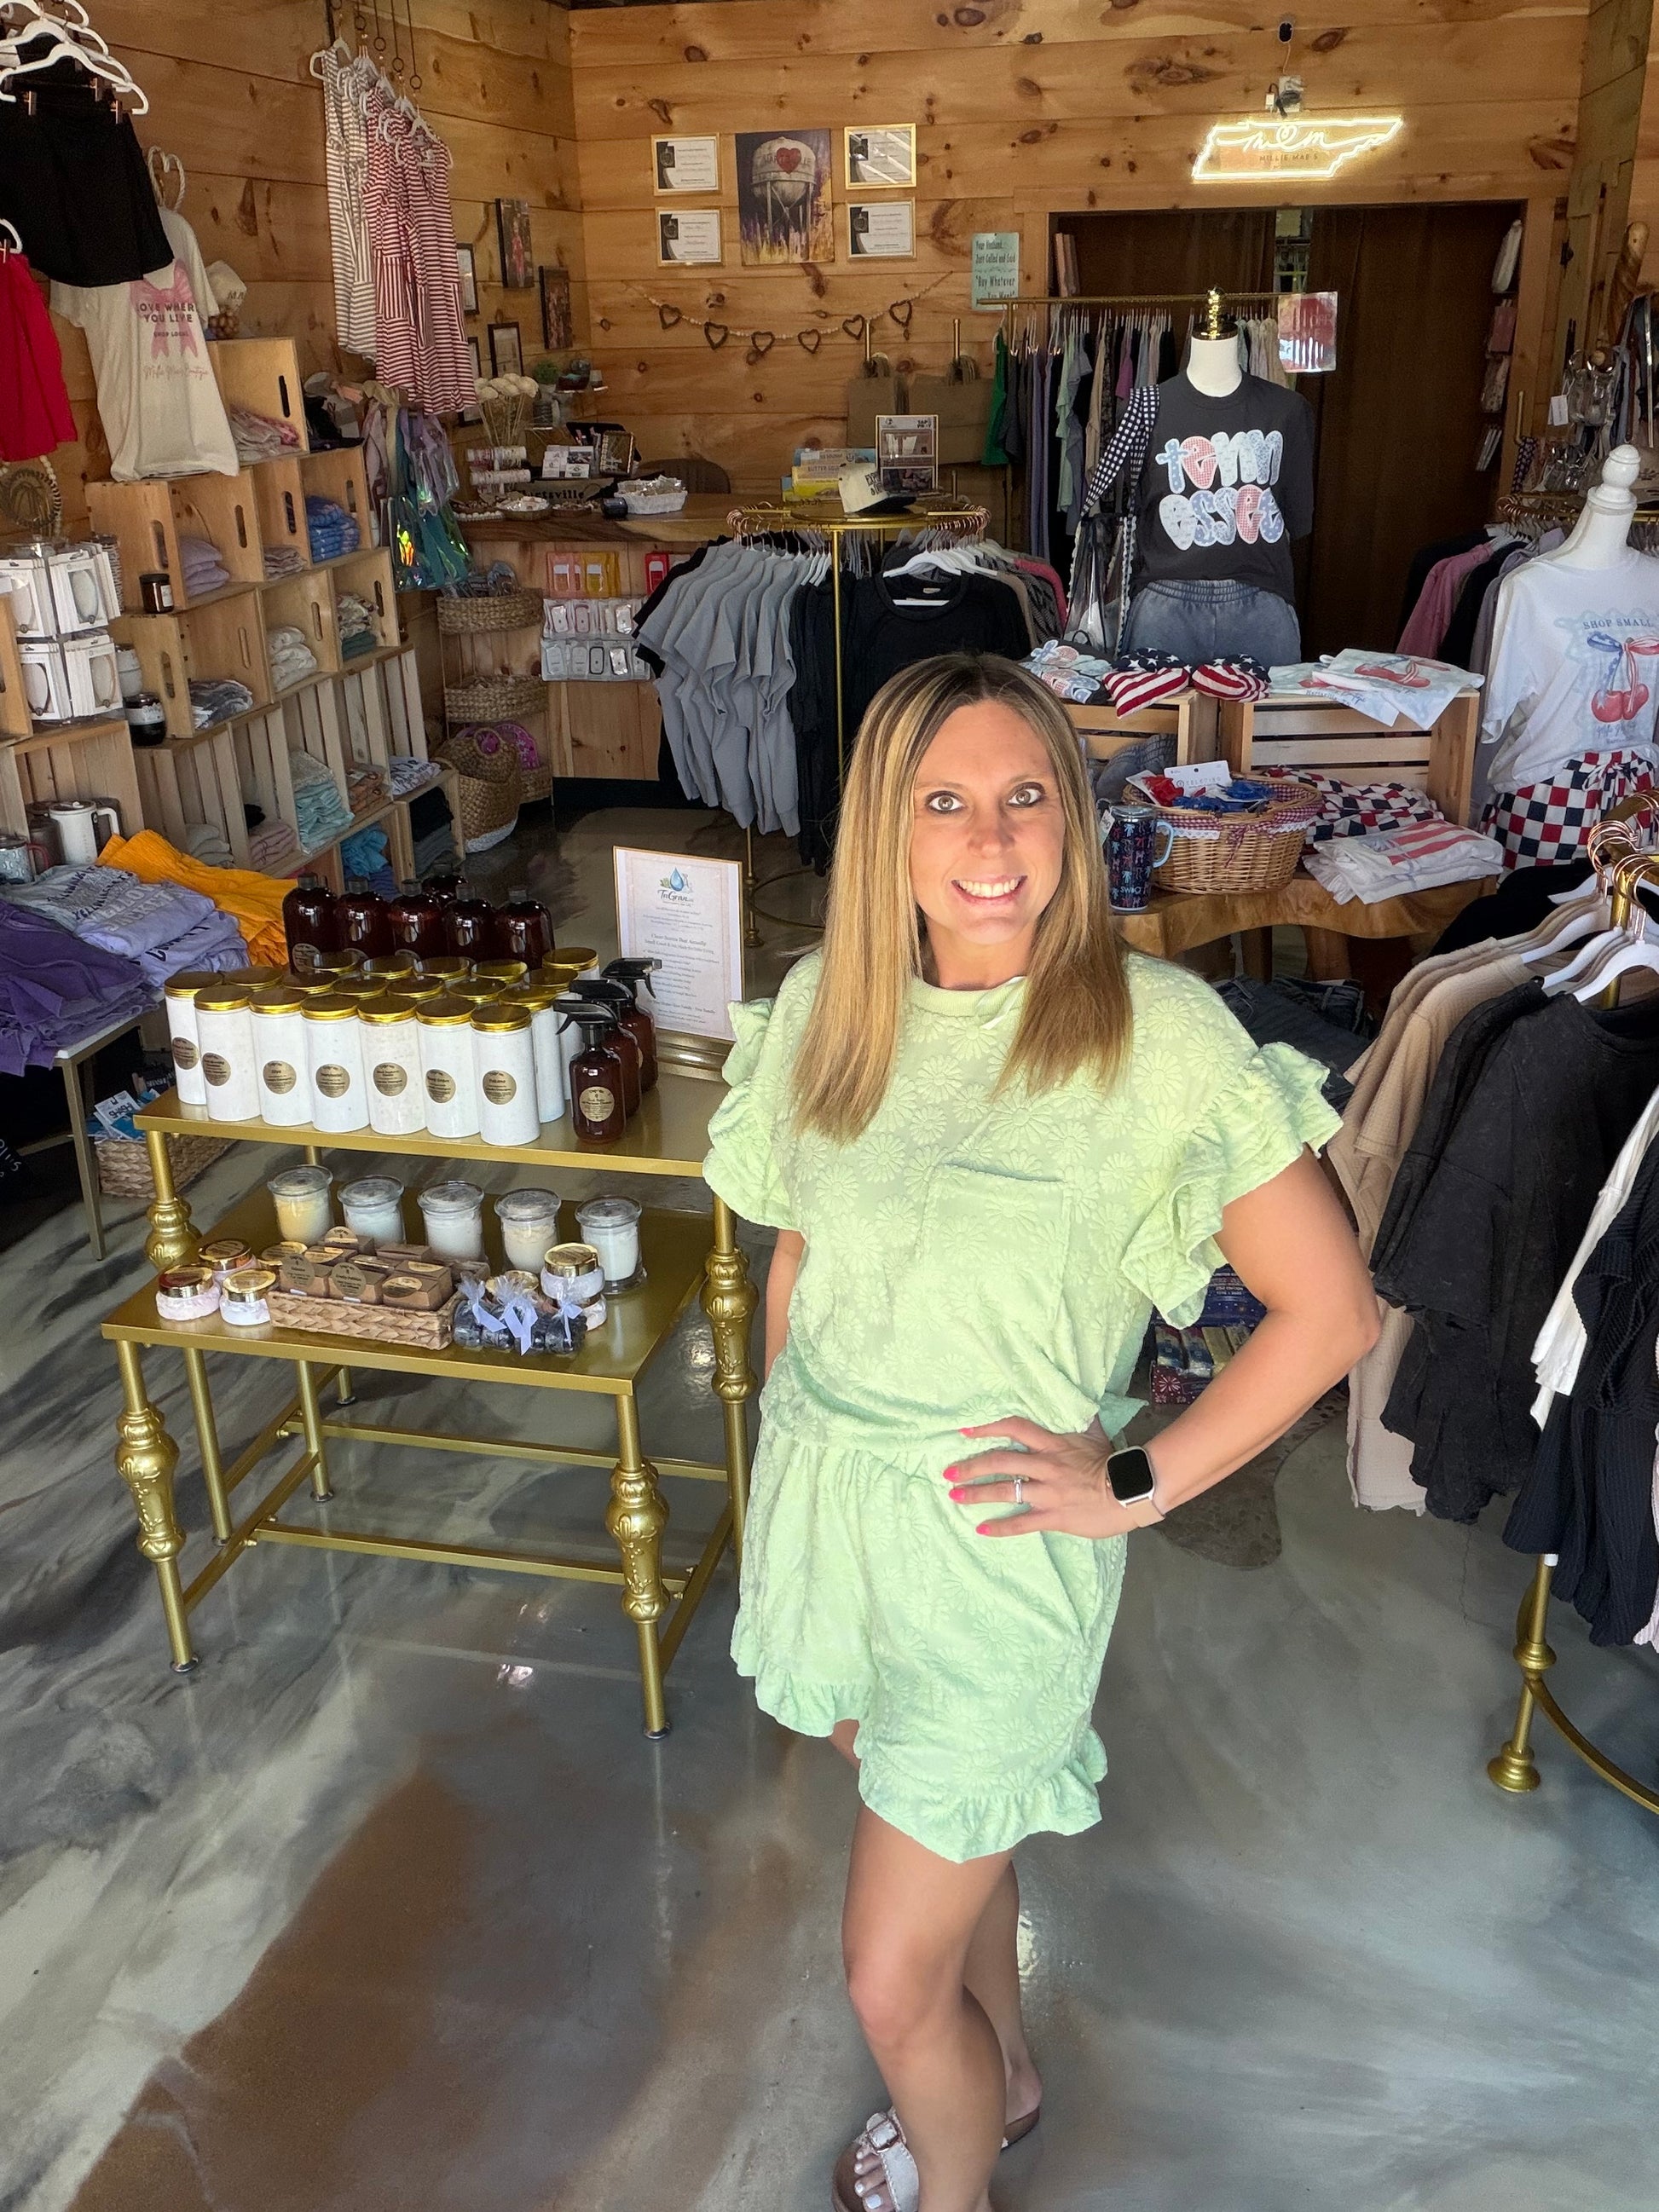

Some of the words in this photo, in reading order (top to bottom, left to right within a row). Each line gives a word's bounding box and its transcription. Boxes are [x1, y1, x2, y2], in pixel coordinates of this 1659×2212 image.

[1259, 153, 1289, 162] MILLIE
[986, 253, 997, 263] Called
[1007, 252, 1016, 263] Said
[989, 275, 1015, 286] Whatever
[138, 303, 161, 312] OVE
[165, 303, 195, 312] WHER
[143, 314, 165, 323] YOU
[169, 314, 194, 323] LIVE
[1583, 619, 1612, 630] SHOP
[1616, 618, 1653, 629] SMALL
